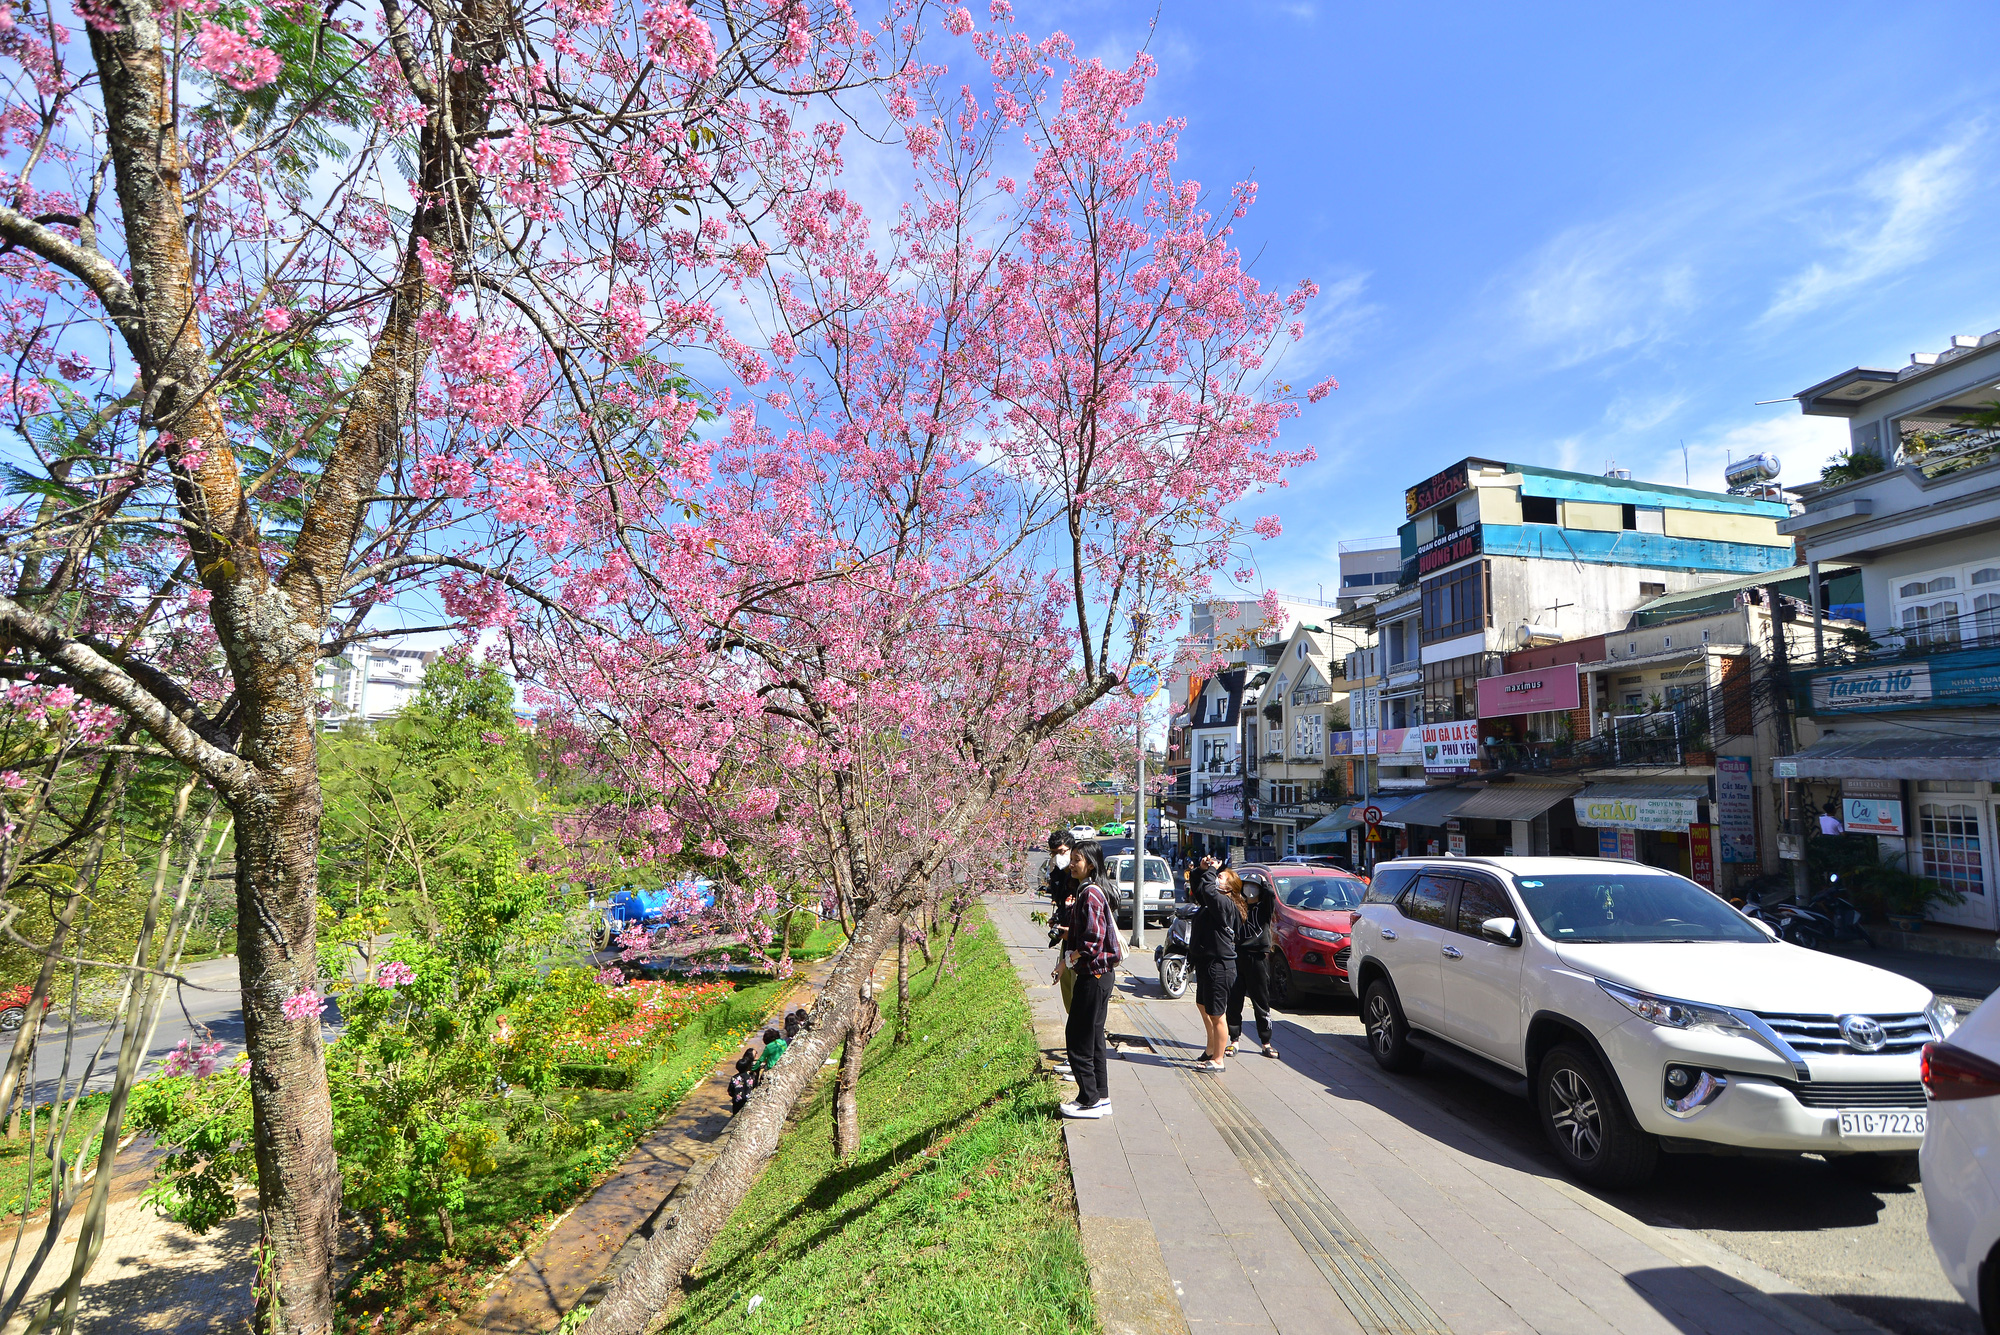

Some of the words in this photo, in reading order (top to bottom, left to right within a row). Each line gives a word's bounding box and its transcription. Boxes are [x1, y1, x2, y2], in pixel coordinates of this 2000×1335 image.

[1432, 472, 1446, 486] BIA
[1418, 474, 1463, 509] SAIGON
[1447, 531, 1459, 541] GIA
[1420, 548, 1450, 573] HƯƠNG
[1452, 536, 1473, 560] XƯA
[1504, 681, 1542, 693] maximus
[1827, 673, 1880, 698] Tania
[1422, 724, 1437, 743] LẨU
[1439, 726, 1450, 742] GÀ
[1451, 725, 1462, 741] LÁ
[1464, 723, 1470, 740] É
[1442, 742, 1459, 756] PHÚ
[1460, 741, 1476, 755] YÊN
[1722, 762, 1745, 771] CHÂU
[1734, 783, 1748, 792] May
[1588, 800, 1637, 821] CHÂU
[1852, 800, 1871, 819] Cà
[1691, 827, 1709, 839] PHOTO
[1694, 844, 1708, 857] COPY
[1695, 858, 1709, 870] CẮT
[1841, 1114, 1925, 1133] 51G-722.8
